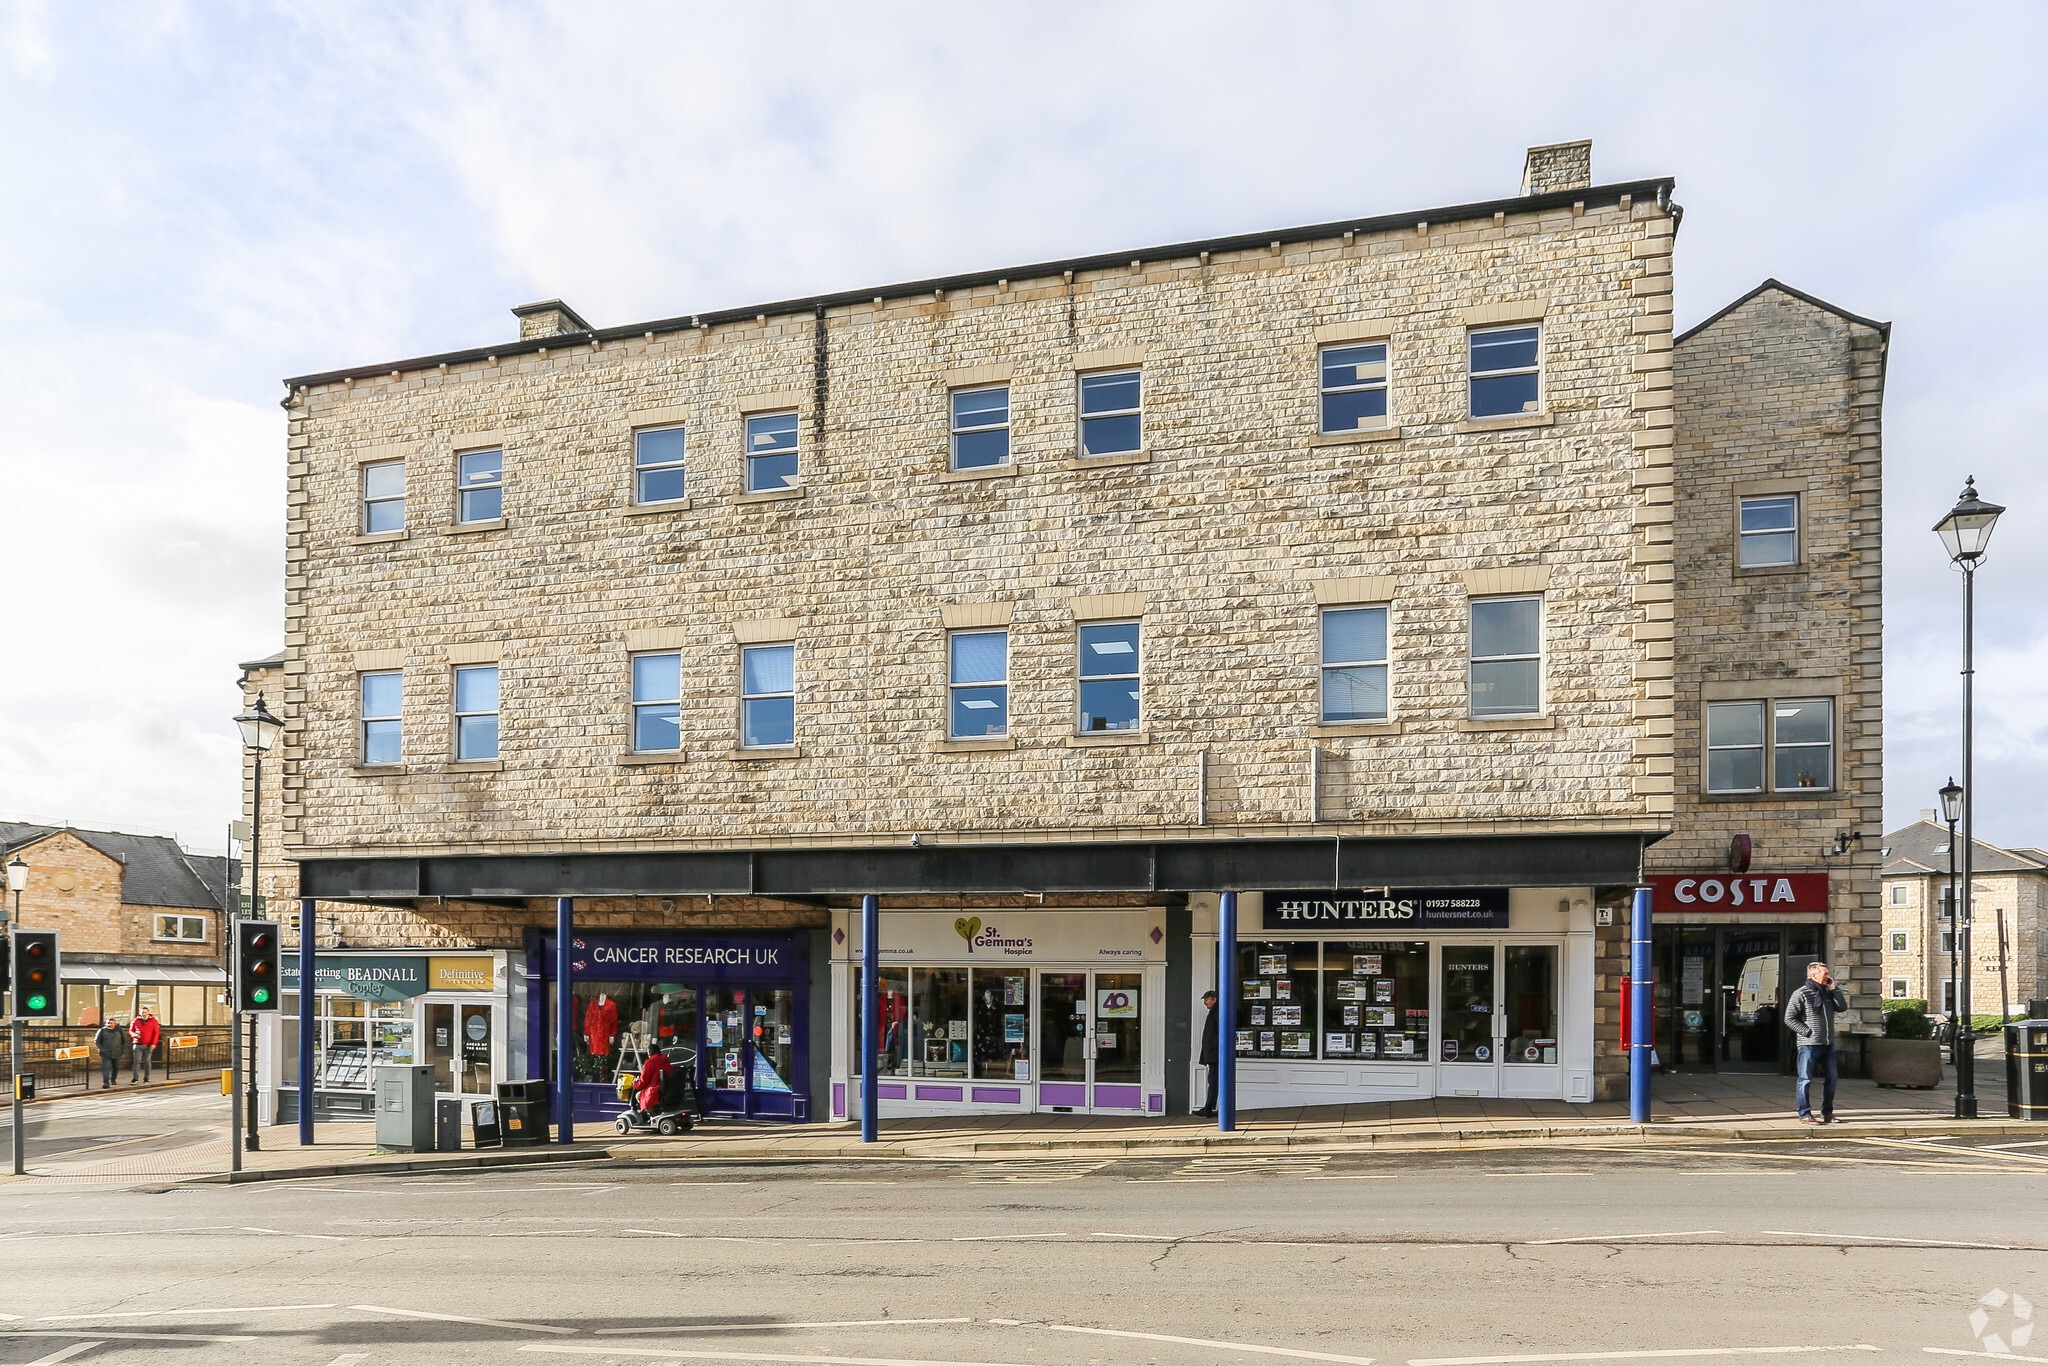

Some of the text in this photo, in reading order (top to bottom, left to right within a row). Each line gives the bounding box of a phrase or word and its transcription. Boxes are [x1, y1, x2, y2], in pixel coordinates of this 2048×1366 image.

[1674, 878, 1796, 906] COSTA
[1277, 899, 1480, 919] HUNTERS 01937 588228
[1426, 909, 1494, 919] huntersnet.co.uk
[985, 926, 1001, 938] St.
[974, 935, 1033, 947] Gemma's
[593, 947, 778, 965] CANCER RESEARCH UK
[1004, 947, 1033, 957] Hospice
[1098, 948, 1142, 957] Always caring
[314, 967, 342, 980] etting
[347, 967, 418, 981] BEADNALL
[440, 968, 484, 979] Definitive
[348, 981, 384, 997] Copley
[1102, 992, 1130, 1009] 40
